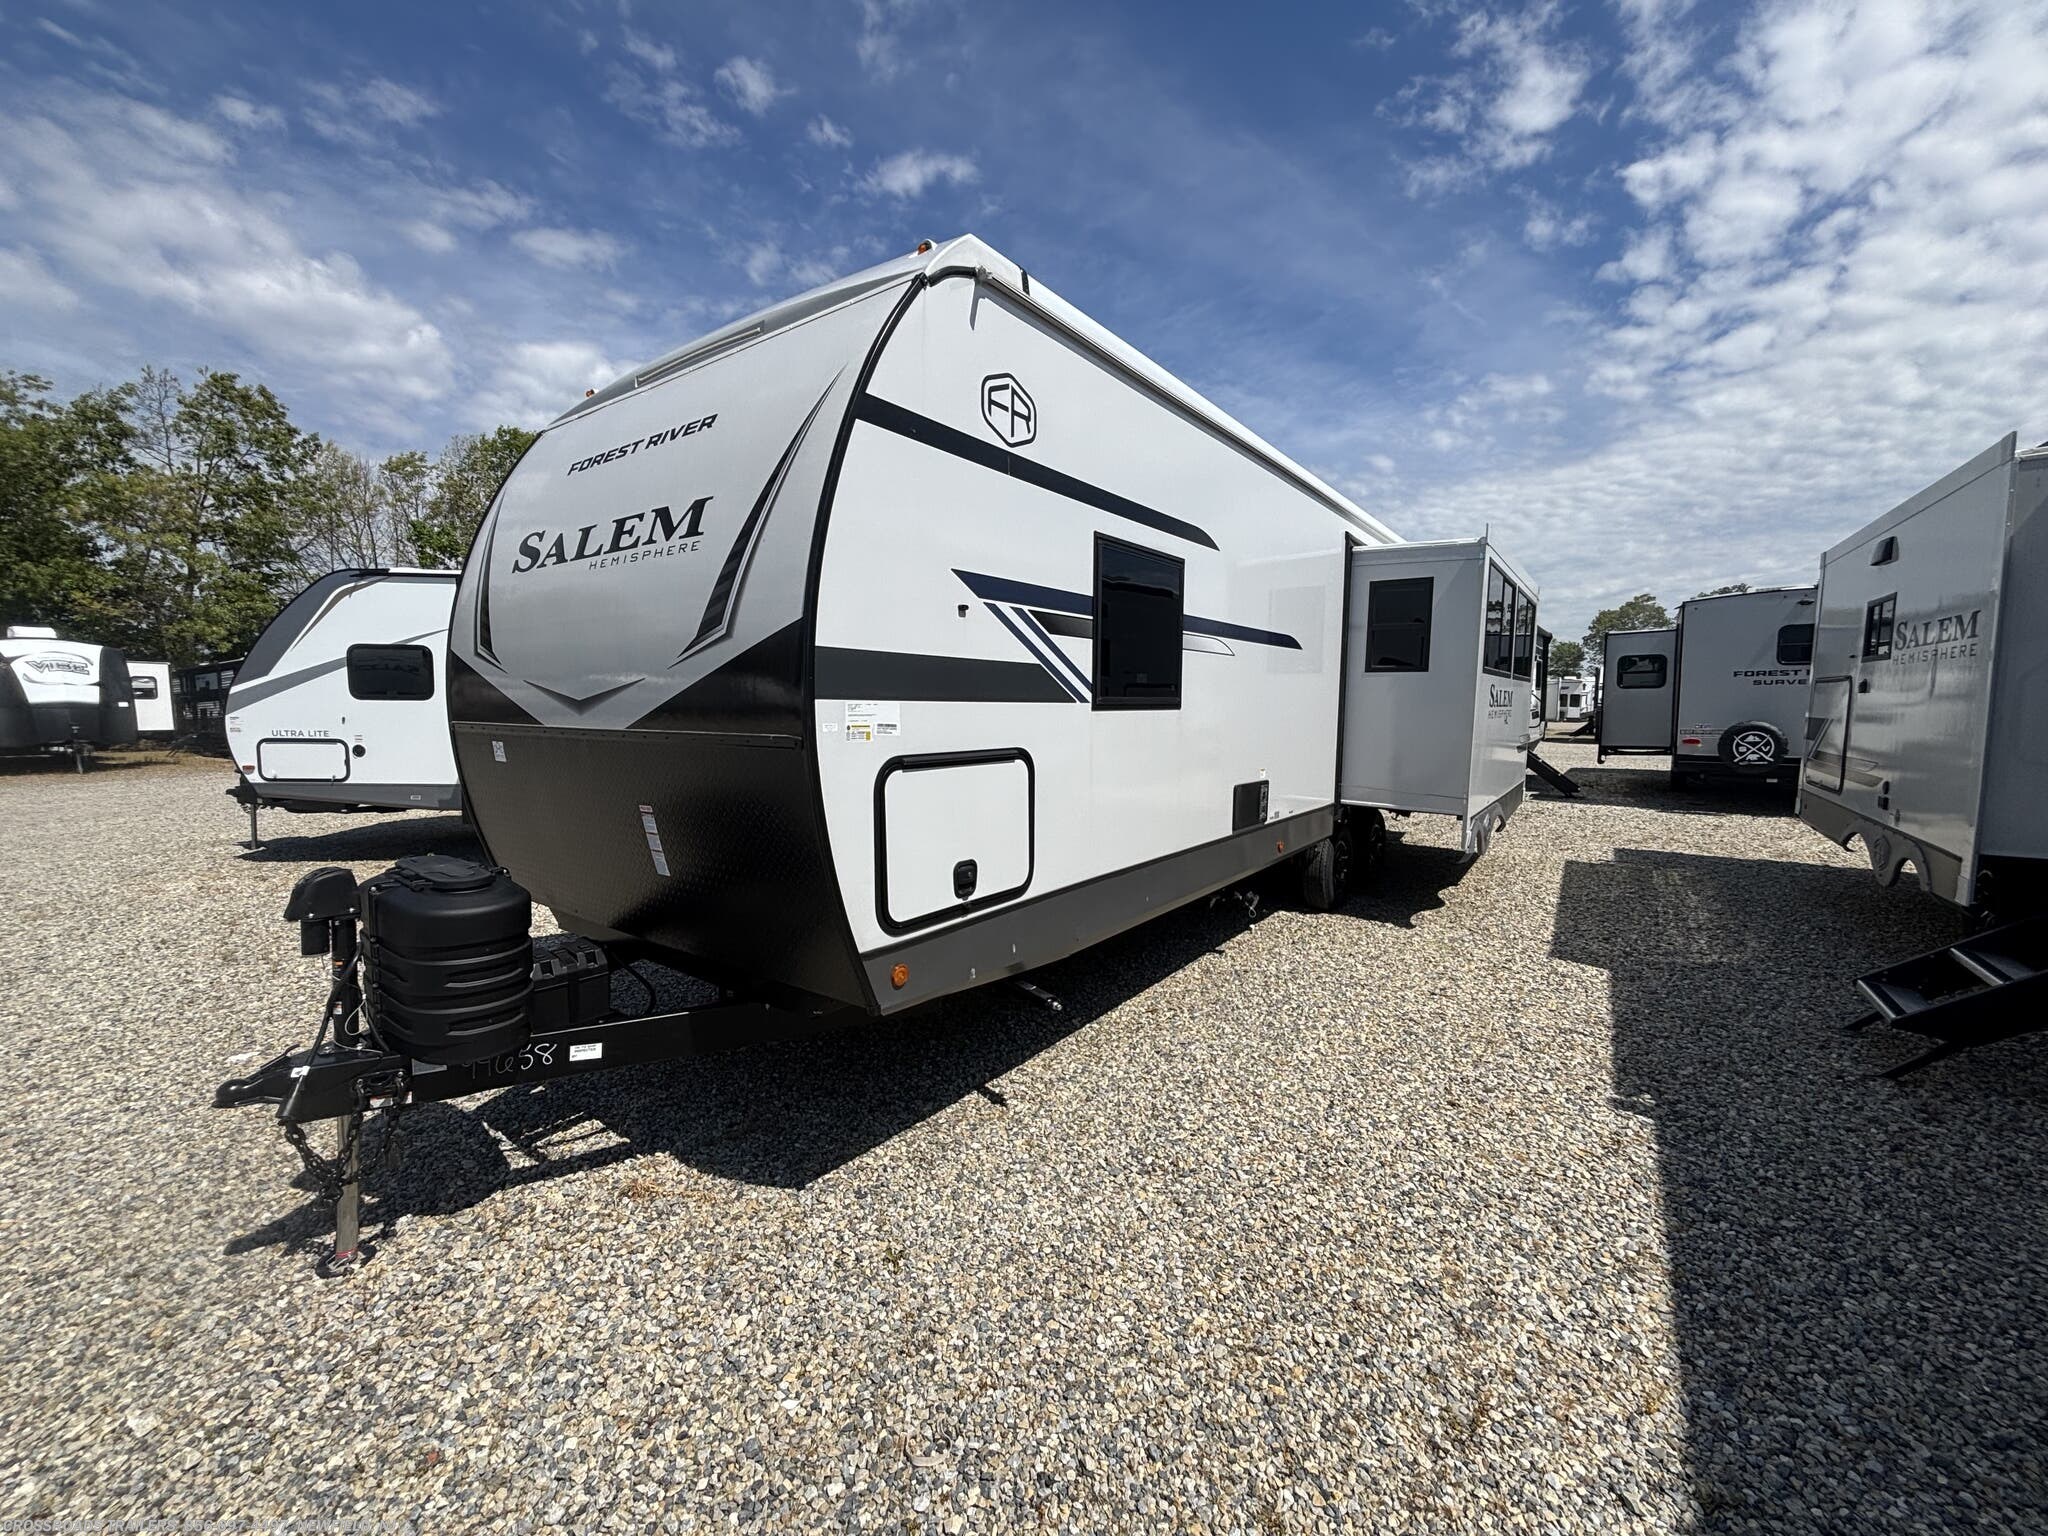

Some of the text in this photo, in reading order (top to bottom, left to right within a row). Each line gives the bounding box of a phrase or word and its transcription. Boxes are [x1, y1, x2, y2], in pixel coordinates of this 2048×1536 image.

[567, 413, 718, 476] FOREST RIVER
[511, 496, 714, 574] SALEM
[589, 540, 701, 570] HEMISPHERE
[1894, 610, 1981, 650] SALEM
[1892, 643, 1978, 665] HEMISPHERE
[1733, 669, 1802, 677] FOREST
[1489, 683, 1513, 707] SALEM
[271, 729, 305, 737] ULTRA
